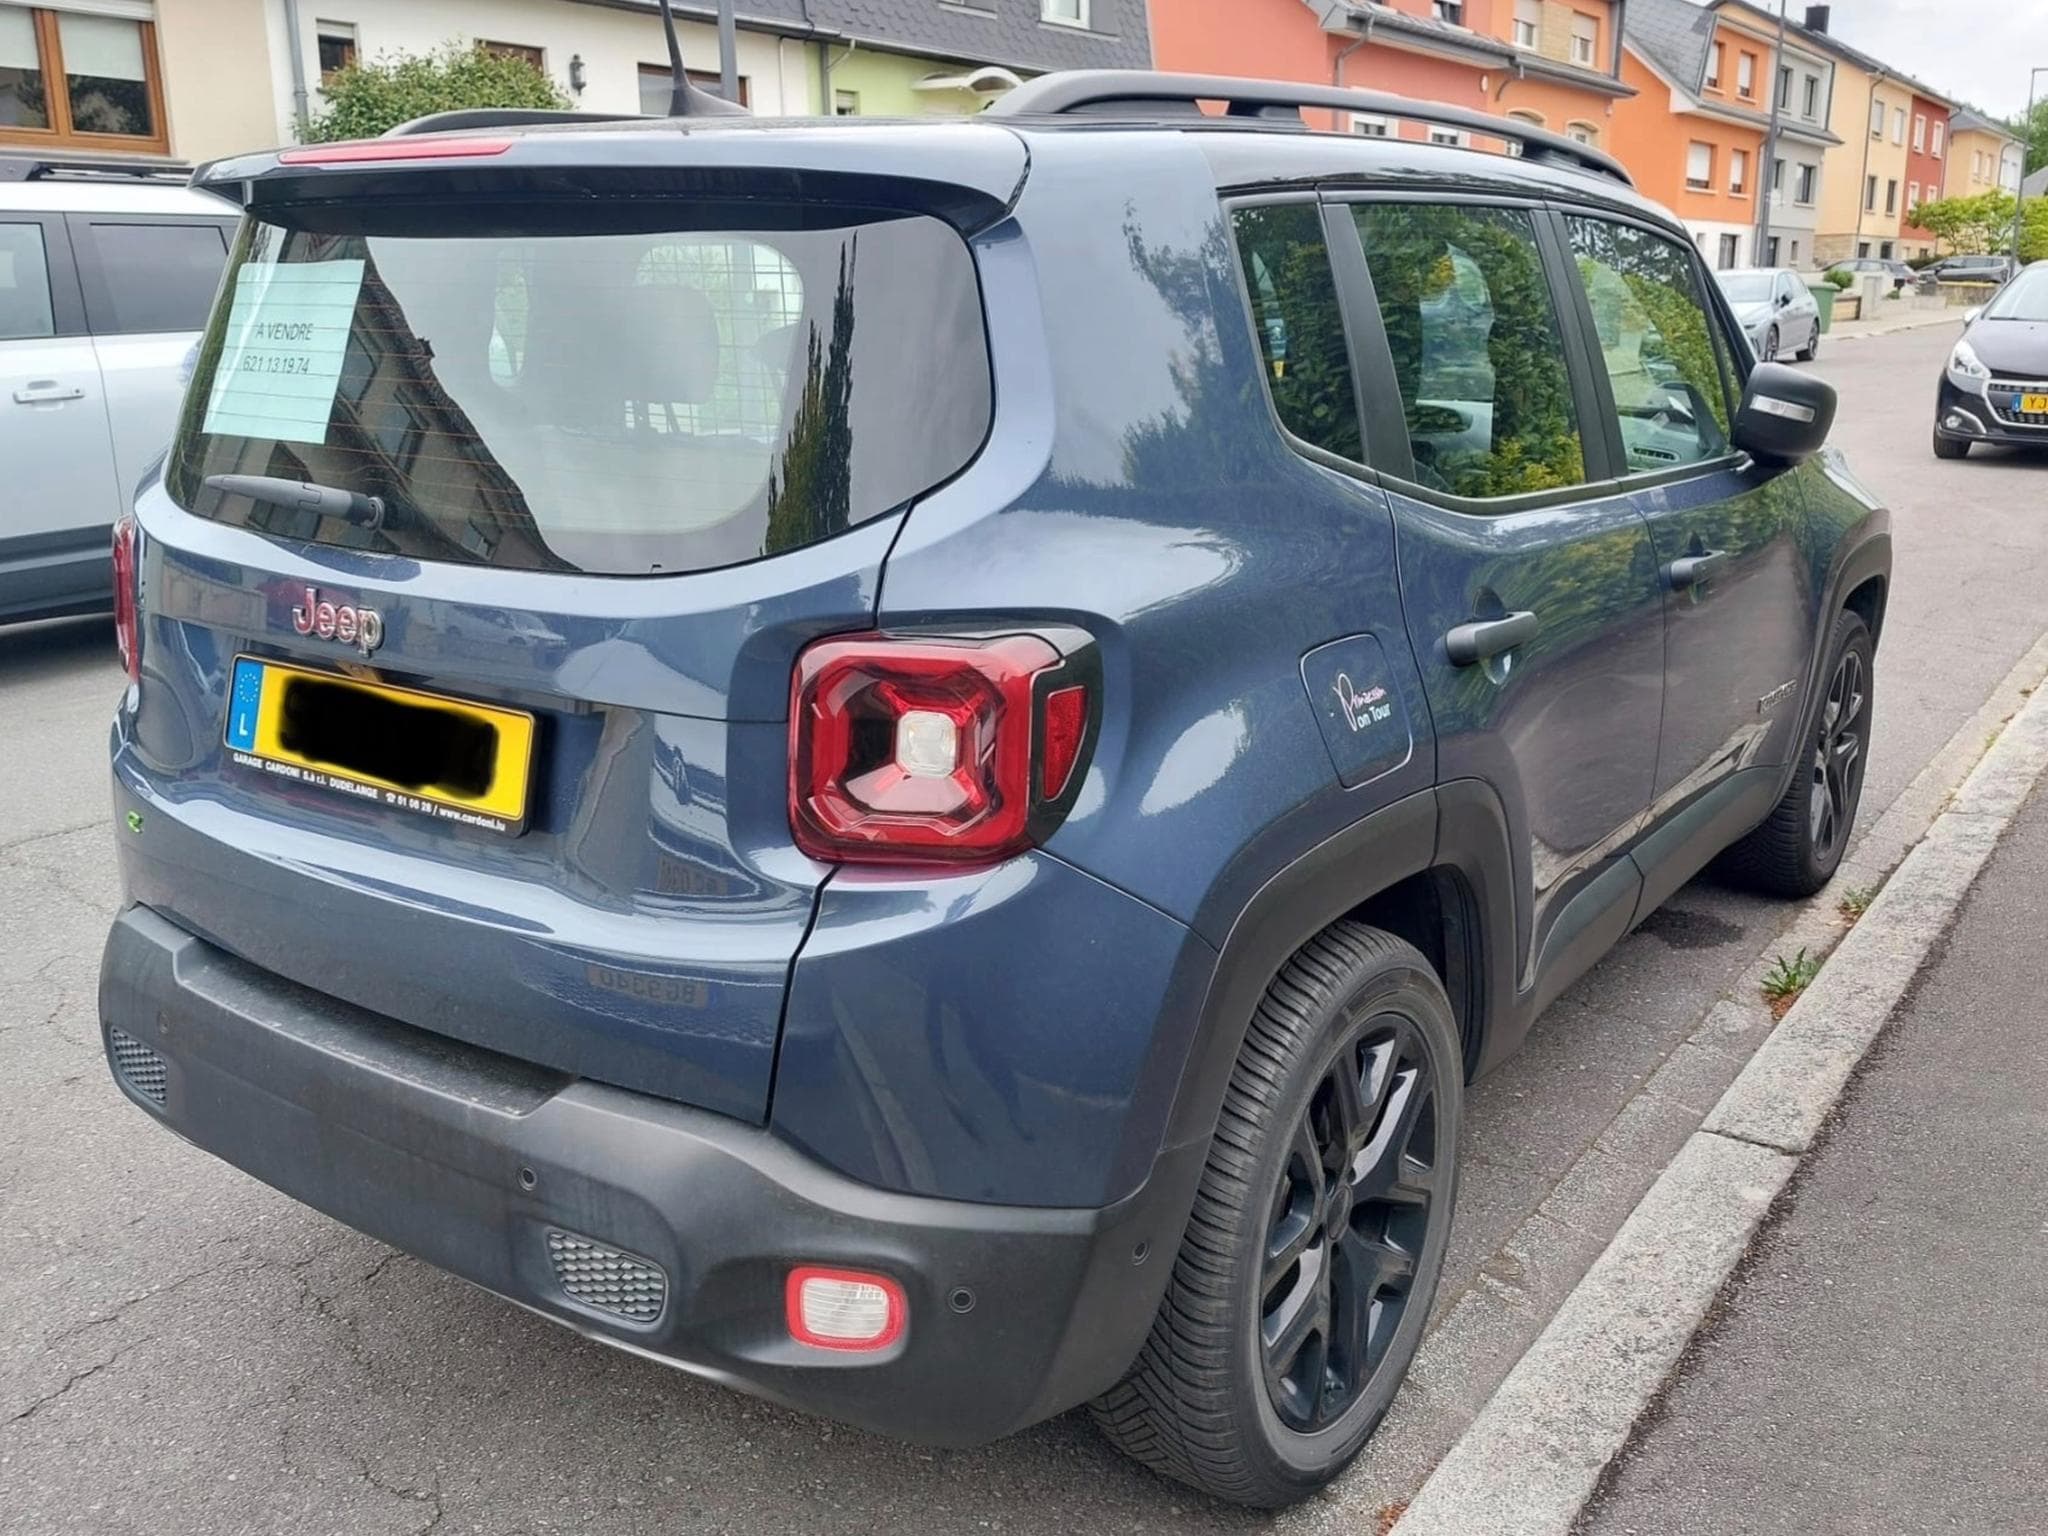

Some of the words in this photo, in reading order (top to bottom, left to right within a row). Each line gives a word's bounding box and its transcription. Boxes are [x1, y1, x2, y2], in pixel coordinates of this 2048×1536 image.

[256, 323, 264, 338] A
[268, 323, 314, 340] VENDRE
[243, 355, 264, 372] 621
[267, 356, 281, 373] 13
[297, 357, 310, 374] 74
[292, 586, 385, 658] Jeep
[239, 713, 248, 736] L
[1357, 713, 1371, 728] on
[1369, 703, 1391, 722] Tour
[233, 752, 263, 769] GARAGE
[265, 761, 300, 778] CARDONI
[329, 777, 378, 799] DUDELANGE
[439, 807, 506, 832] www.cardoni.lu
